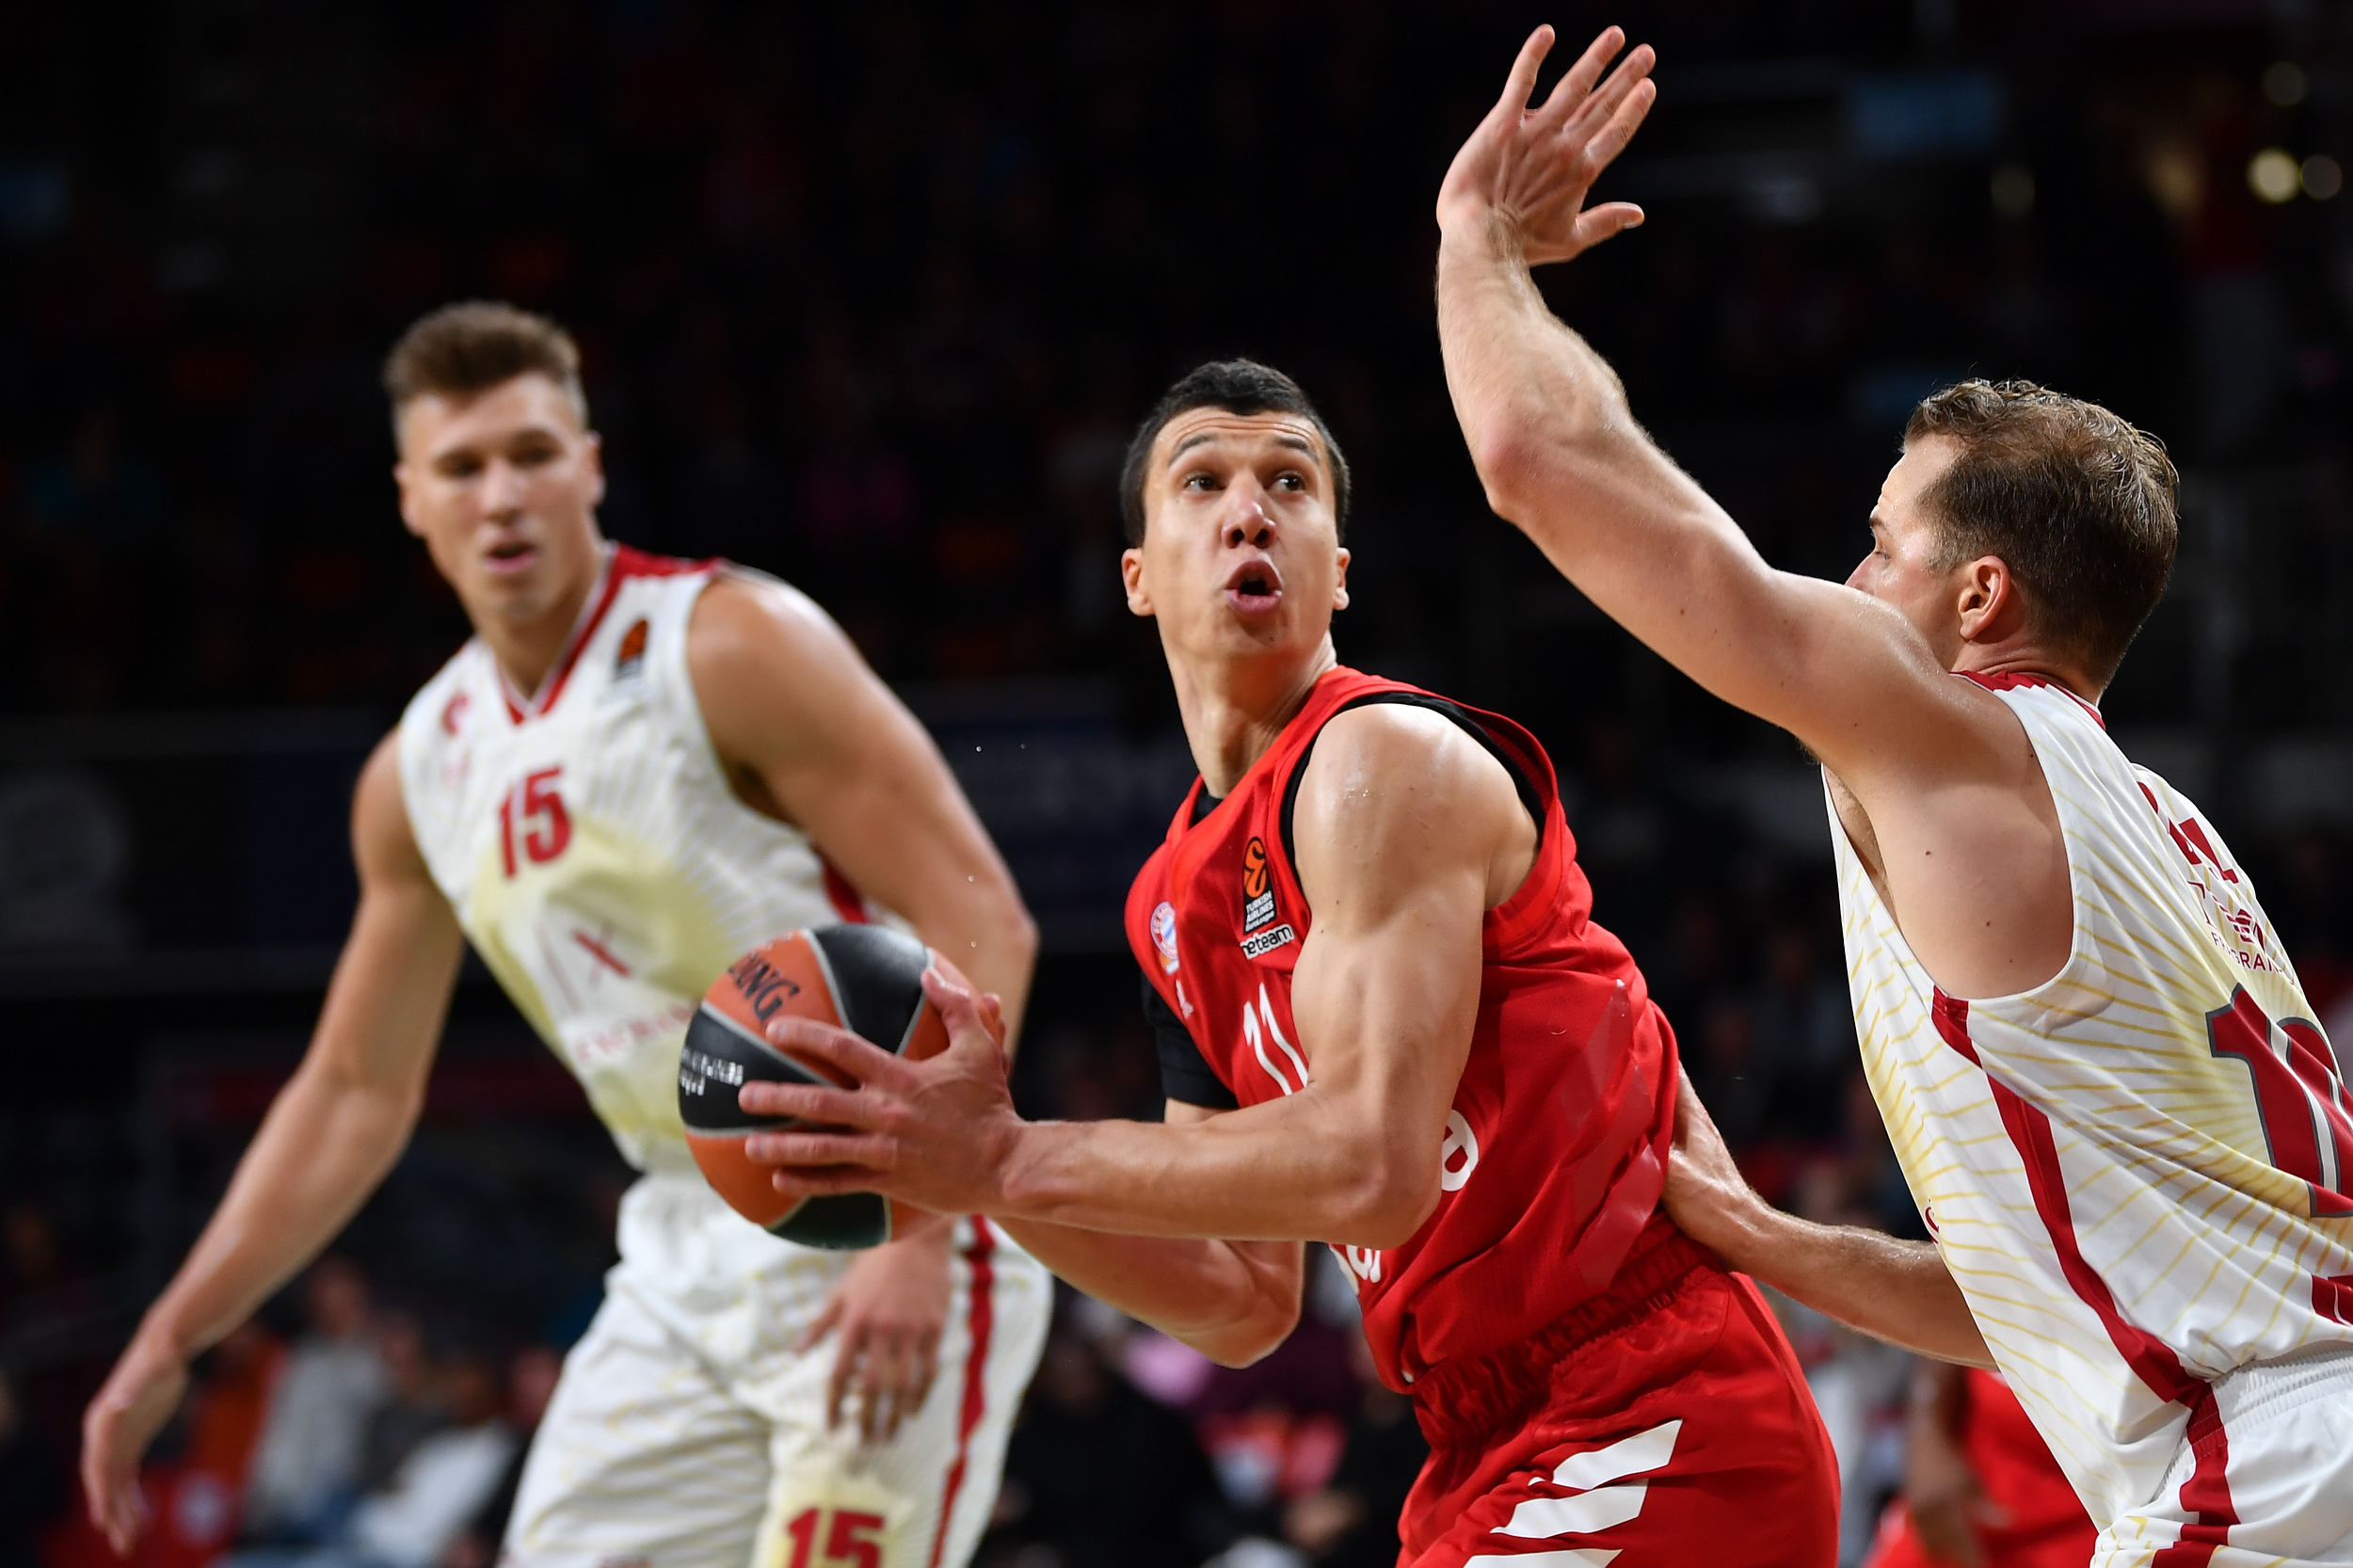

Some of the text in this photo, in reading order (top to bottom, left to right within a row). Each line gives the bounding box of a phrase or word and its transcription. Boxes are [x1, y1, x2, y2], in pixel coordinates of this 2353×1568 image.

[499, 767, 571, 879] 15
[1243, 983, 1309, 1096] 11
[787, 1506, 887, 1568] 15
